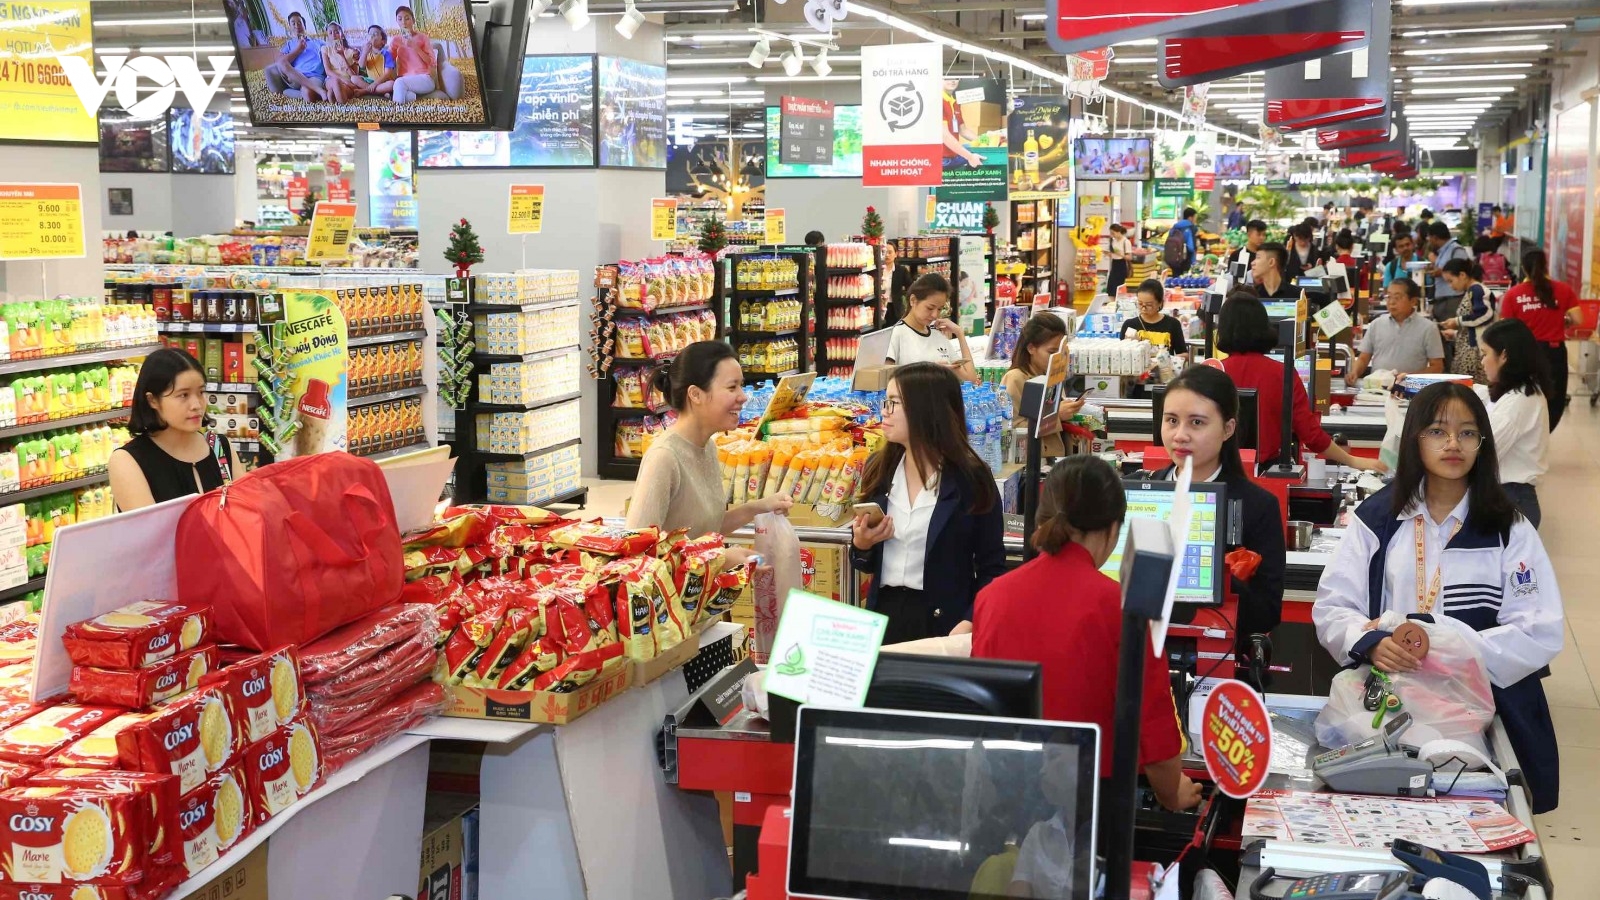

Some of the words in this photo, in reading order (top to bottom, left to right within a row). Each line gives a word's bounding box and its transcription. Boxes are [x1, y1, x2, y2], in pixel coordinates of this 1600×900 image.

[13, 60, 34, 83] 710
[905, 68, 929, 76] HÀNG
[524, 95, 547, 107] app
[550, 93, 580, 104] VinID
[533, 109, 559, 120] miễn
[562, 109, 579, 122] phí
[870, 159, 898, 168] NHANH
[880, 168, 898, 176] LINH
[900, 167, 923, 178] HOẠT
[38, 204, 60, 213] 9.600
[39, 221, 61, 230] 8.300
[936, 214, 983, 227] XANH
[40, 235, 67, 243] 10.000
[285, 308, 334, 337] NESCAFÉ
[302, 403, 327, 416] NESCAFÉ
[149, 633, 172, 650] COSY
[155, 672, 178, 689] COSY
[242, 676, 266, 697] COSY
[163, 722, 194, 751] COSY
[1238, 727, 1253, 746] Pay
[1217, 725, 1255, 770] 50%
[259, 747, 284, 771] COSY
[9, 814, 55, 832] COSY
[180, 801, 208, 831] COSY
[22, 850, 50, 862] Marie
